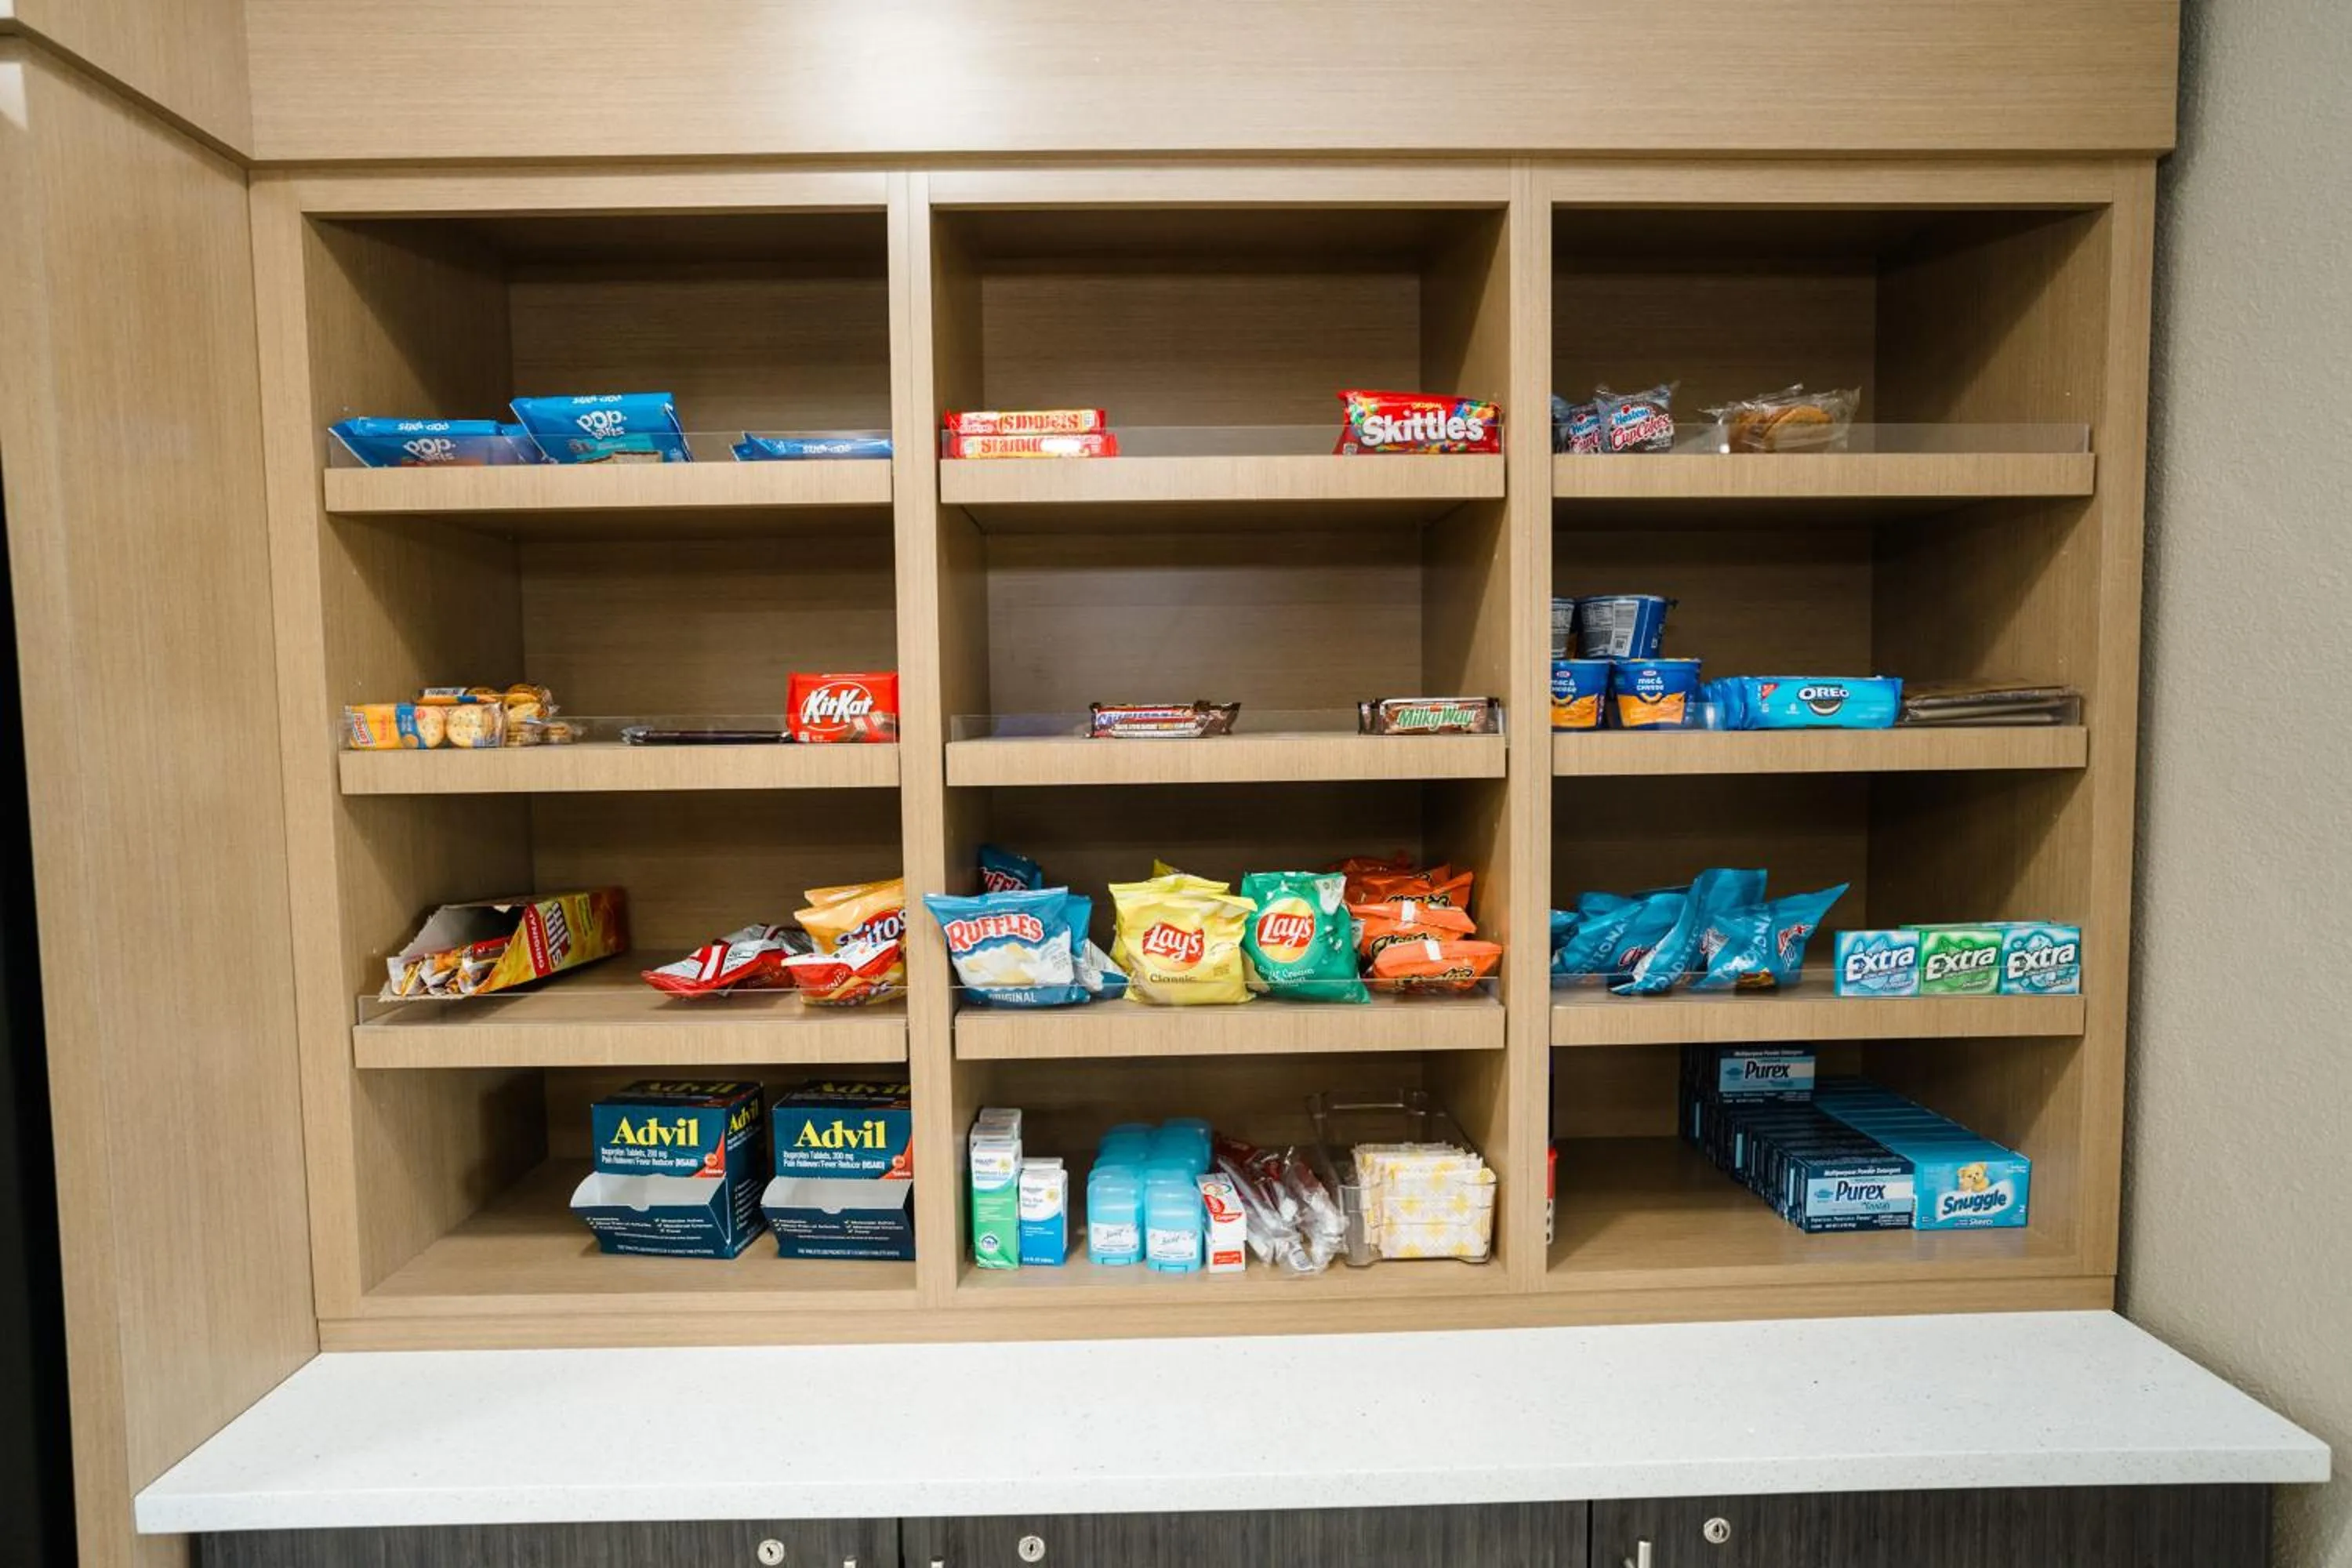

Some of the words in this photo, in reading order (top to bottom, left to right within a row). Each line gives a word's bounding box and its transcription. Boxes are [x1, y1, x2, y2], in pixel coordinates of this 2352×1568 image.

[1360, 410, 1485, 446] Skittles
[801, 688, 874, 725] KitKat
[1798, 687, 1849, 701] OREO
[1260, 913, 1312, 949] Lay's
[1846, 946, 1916, 982] Extra
[1925, 946, 1998, 982] Extra
[2006, 942, 2077, 981] Extra
[1744, 1060, 1791, 1080] Purex
[610, 1116, 700, 1147] Advil
[793, 1119, 887, 1149] Advil
[1835, 1180, 1886, 1202] Purex
[1941, 1188, 2007, 1215] Snuggle
